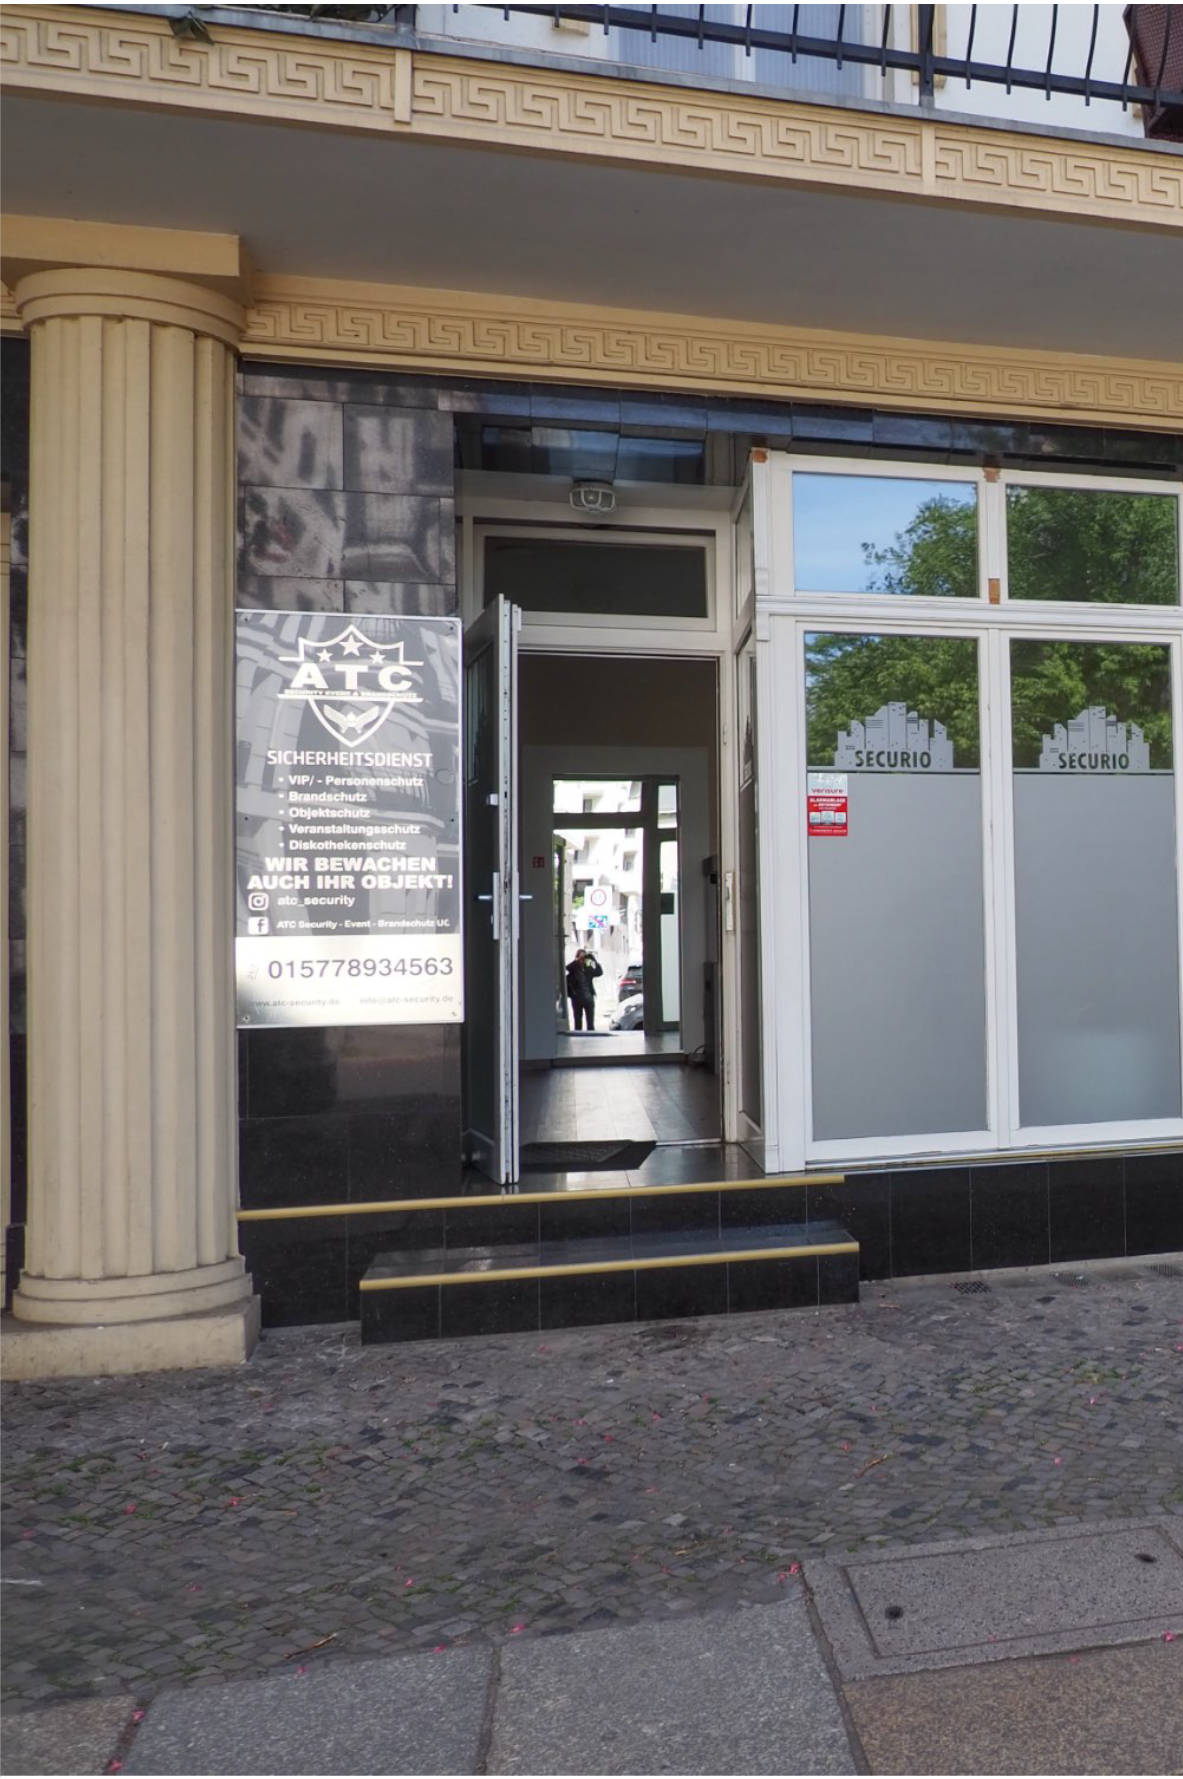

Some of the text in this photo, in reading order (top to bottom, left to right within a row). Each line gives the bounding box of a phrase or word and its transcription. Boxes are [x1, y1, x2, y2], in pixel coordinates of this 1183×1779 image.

[290, 662, 413, 692] ATC
[266, 750, 433, 768] SICHERHEITSDIENST
[855, 750, 932, 769] SECURIO
[1058, 752, 1130, 770] SECURIO
[325, 775, 424, 787] Personenschutz
[288, 791, 368, 802] Brandschutz
[289, 807, 371, 819] Objektschutz
[288, 824, 421, 837] Veranstaltungsschutz
[289, 840, 408, 851] Diskothekenschutz
[264, 857, 437, 872] WIR BEWACHEN
[247, 874, 454, 890] AUCH IHR OBJEKT!
[277, 893, 356, 908] atc_security
[276, 921, 296, 930] ATC
[298, 919, 338, 931] Security
[344, 919, 371, 929] Event
[378, 918, 435, 929] Brandschutz
[268, 957, 454, 979] 015778934563
